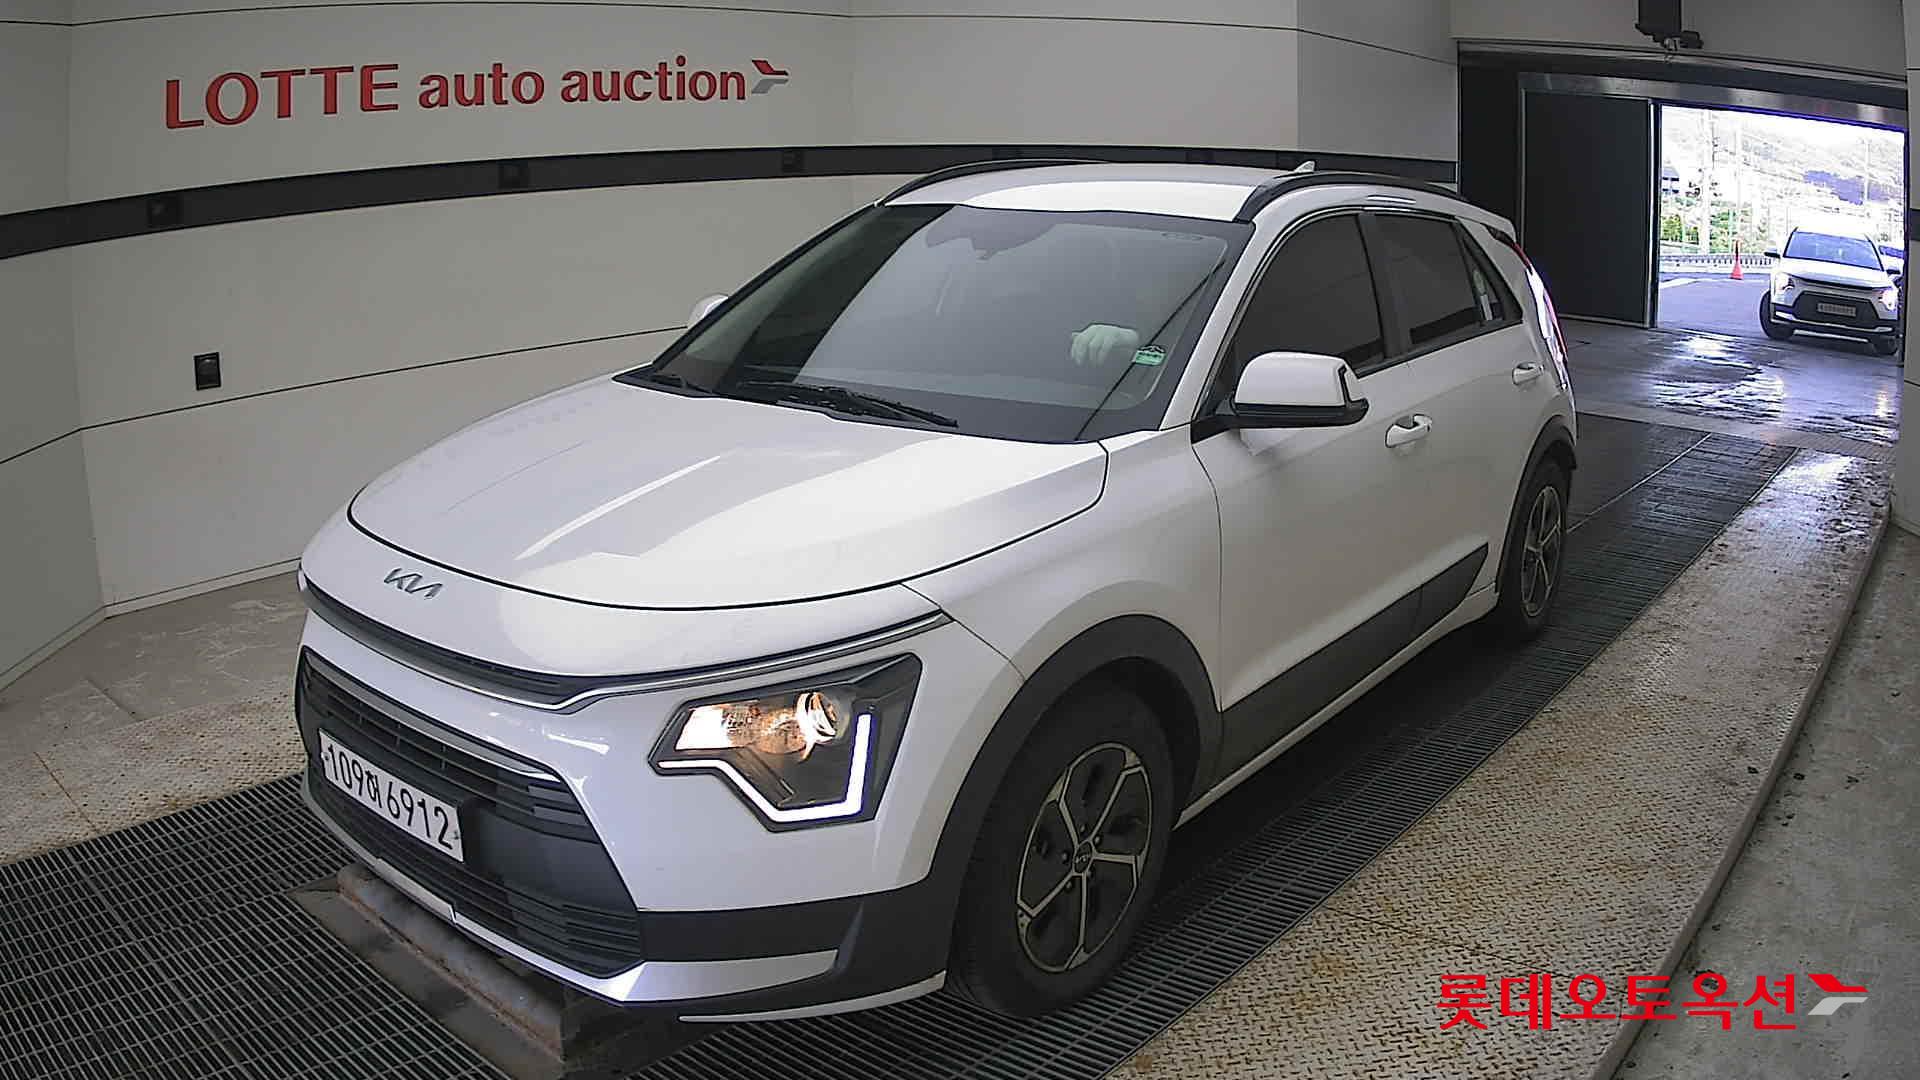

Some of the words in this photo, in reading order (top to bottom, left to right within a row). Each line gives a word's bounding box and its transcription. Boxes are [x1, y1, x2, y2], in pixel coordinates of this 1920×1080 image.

[166, 63, 399, 129] LOTTE
[418, 62, 546, 109] auto
[559, 55, 748, 103] auction
